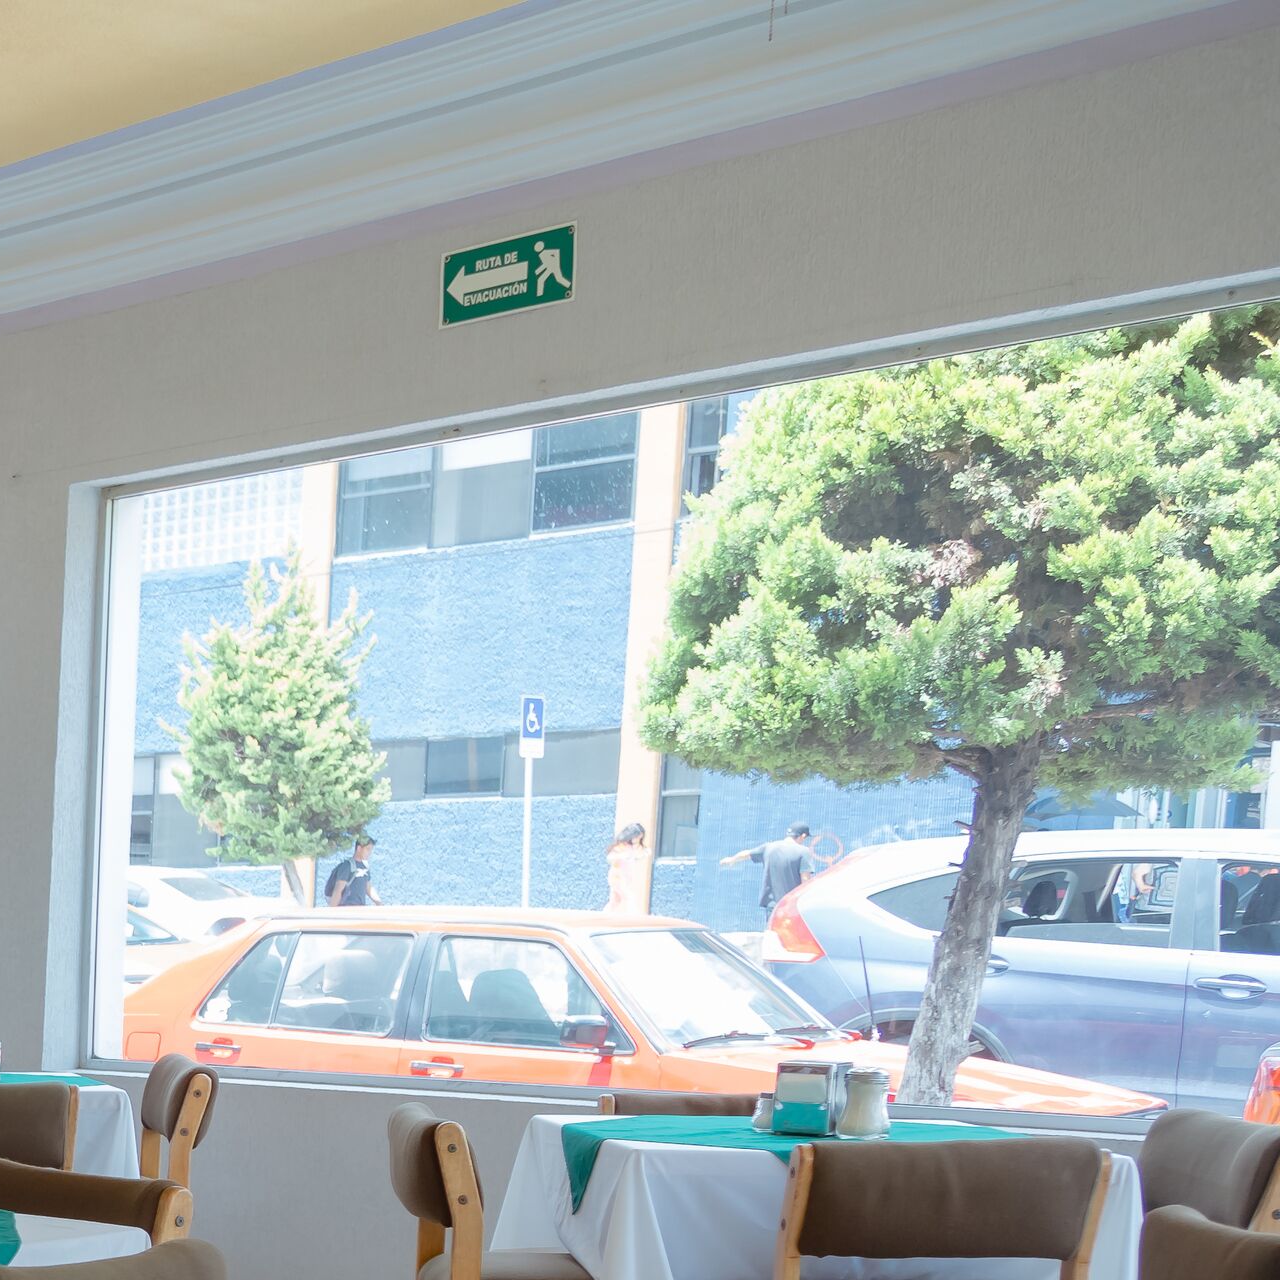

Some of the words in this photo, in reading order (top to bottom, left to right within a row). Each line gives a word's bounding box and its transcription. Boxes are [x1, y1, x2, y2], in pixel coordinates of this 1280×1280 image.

[475, 256, 502, 272] RUTA
[504, 251, 518, 265] DE
[463, 282, 528, 307] EVACUACIÓN
